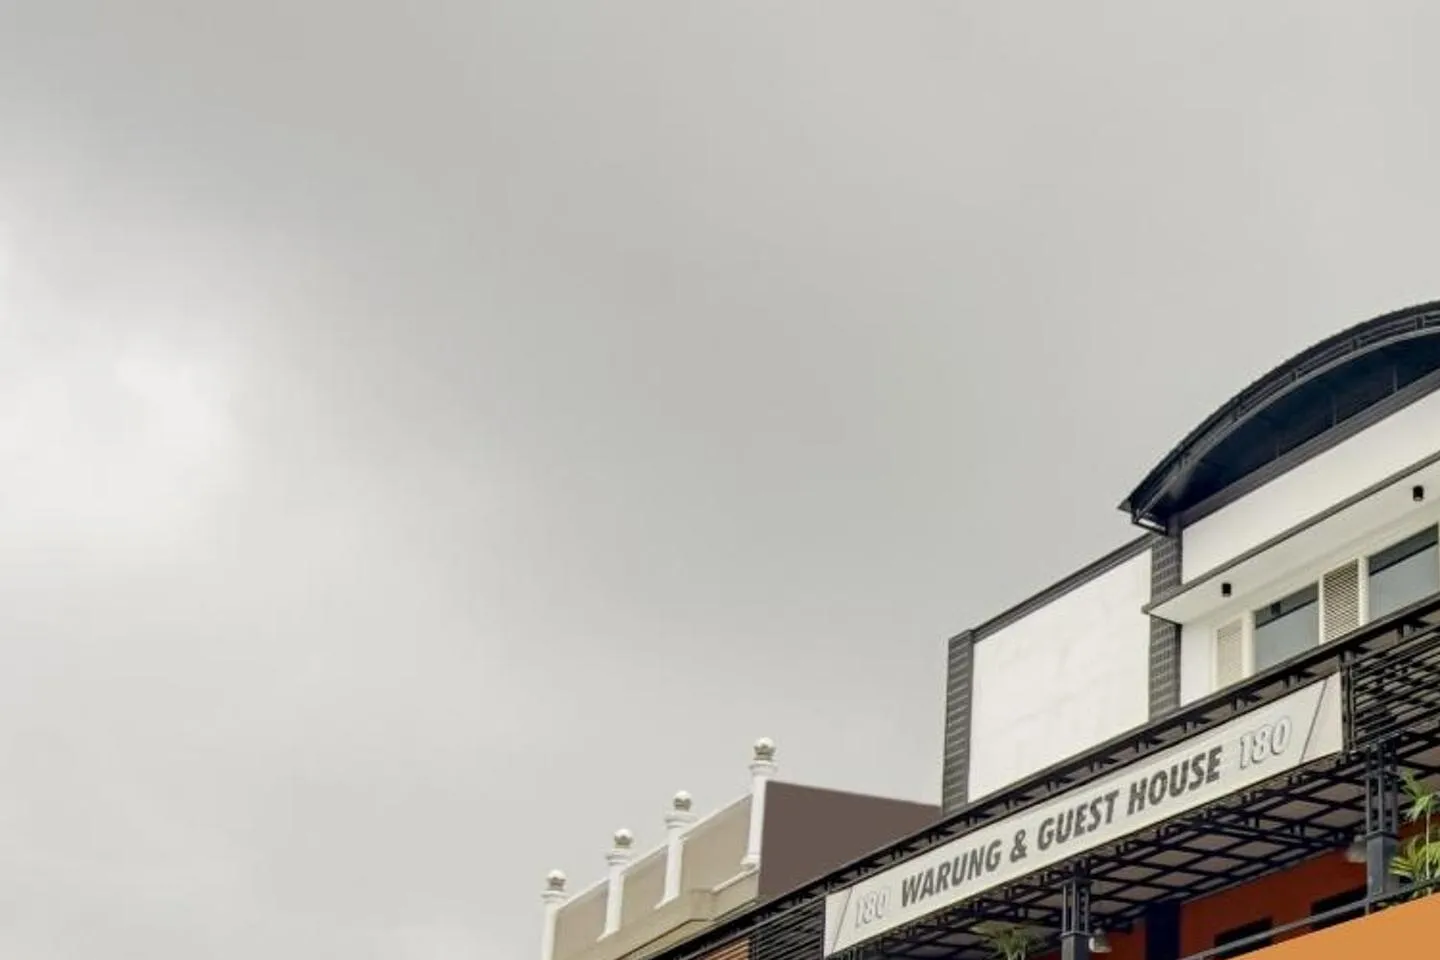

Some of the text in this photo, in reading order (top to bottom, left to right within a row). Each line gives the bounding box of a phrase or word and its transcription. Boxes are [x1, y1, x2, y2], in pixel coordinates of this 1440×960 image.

[853, 715, 1293, 927] 180 WARUNG & GUEST HOUSE 180
